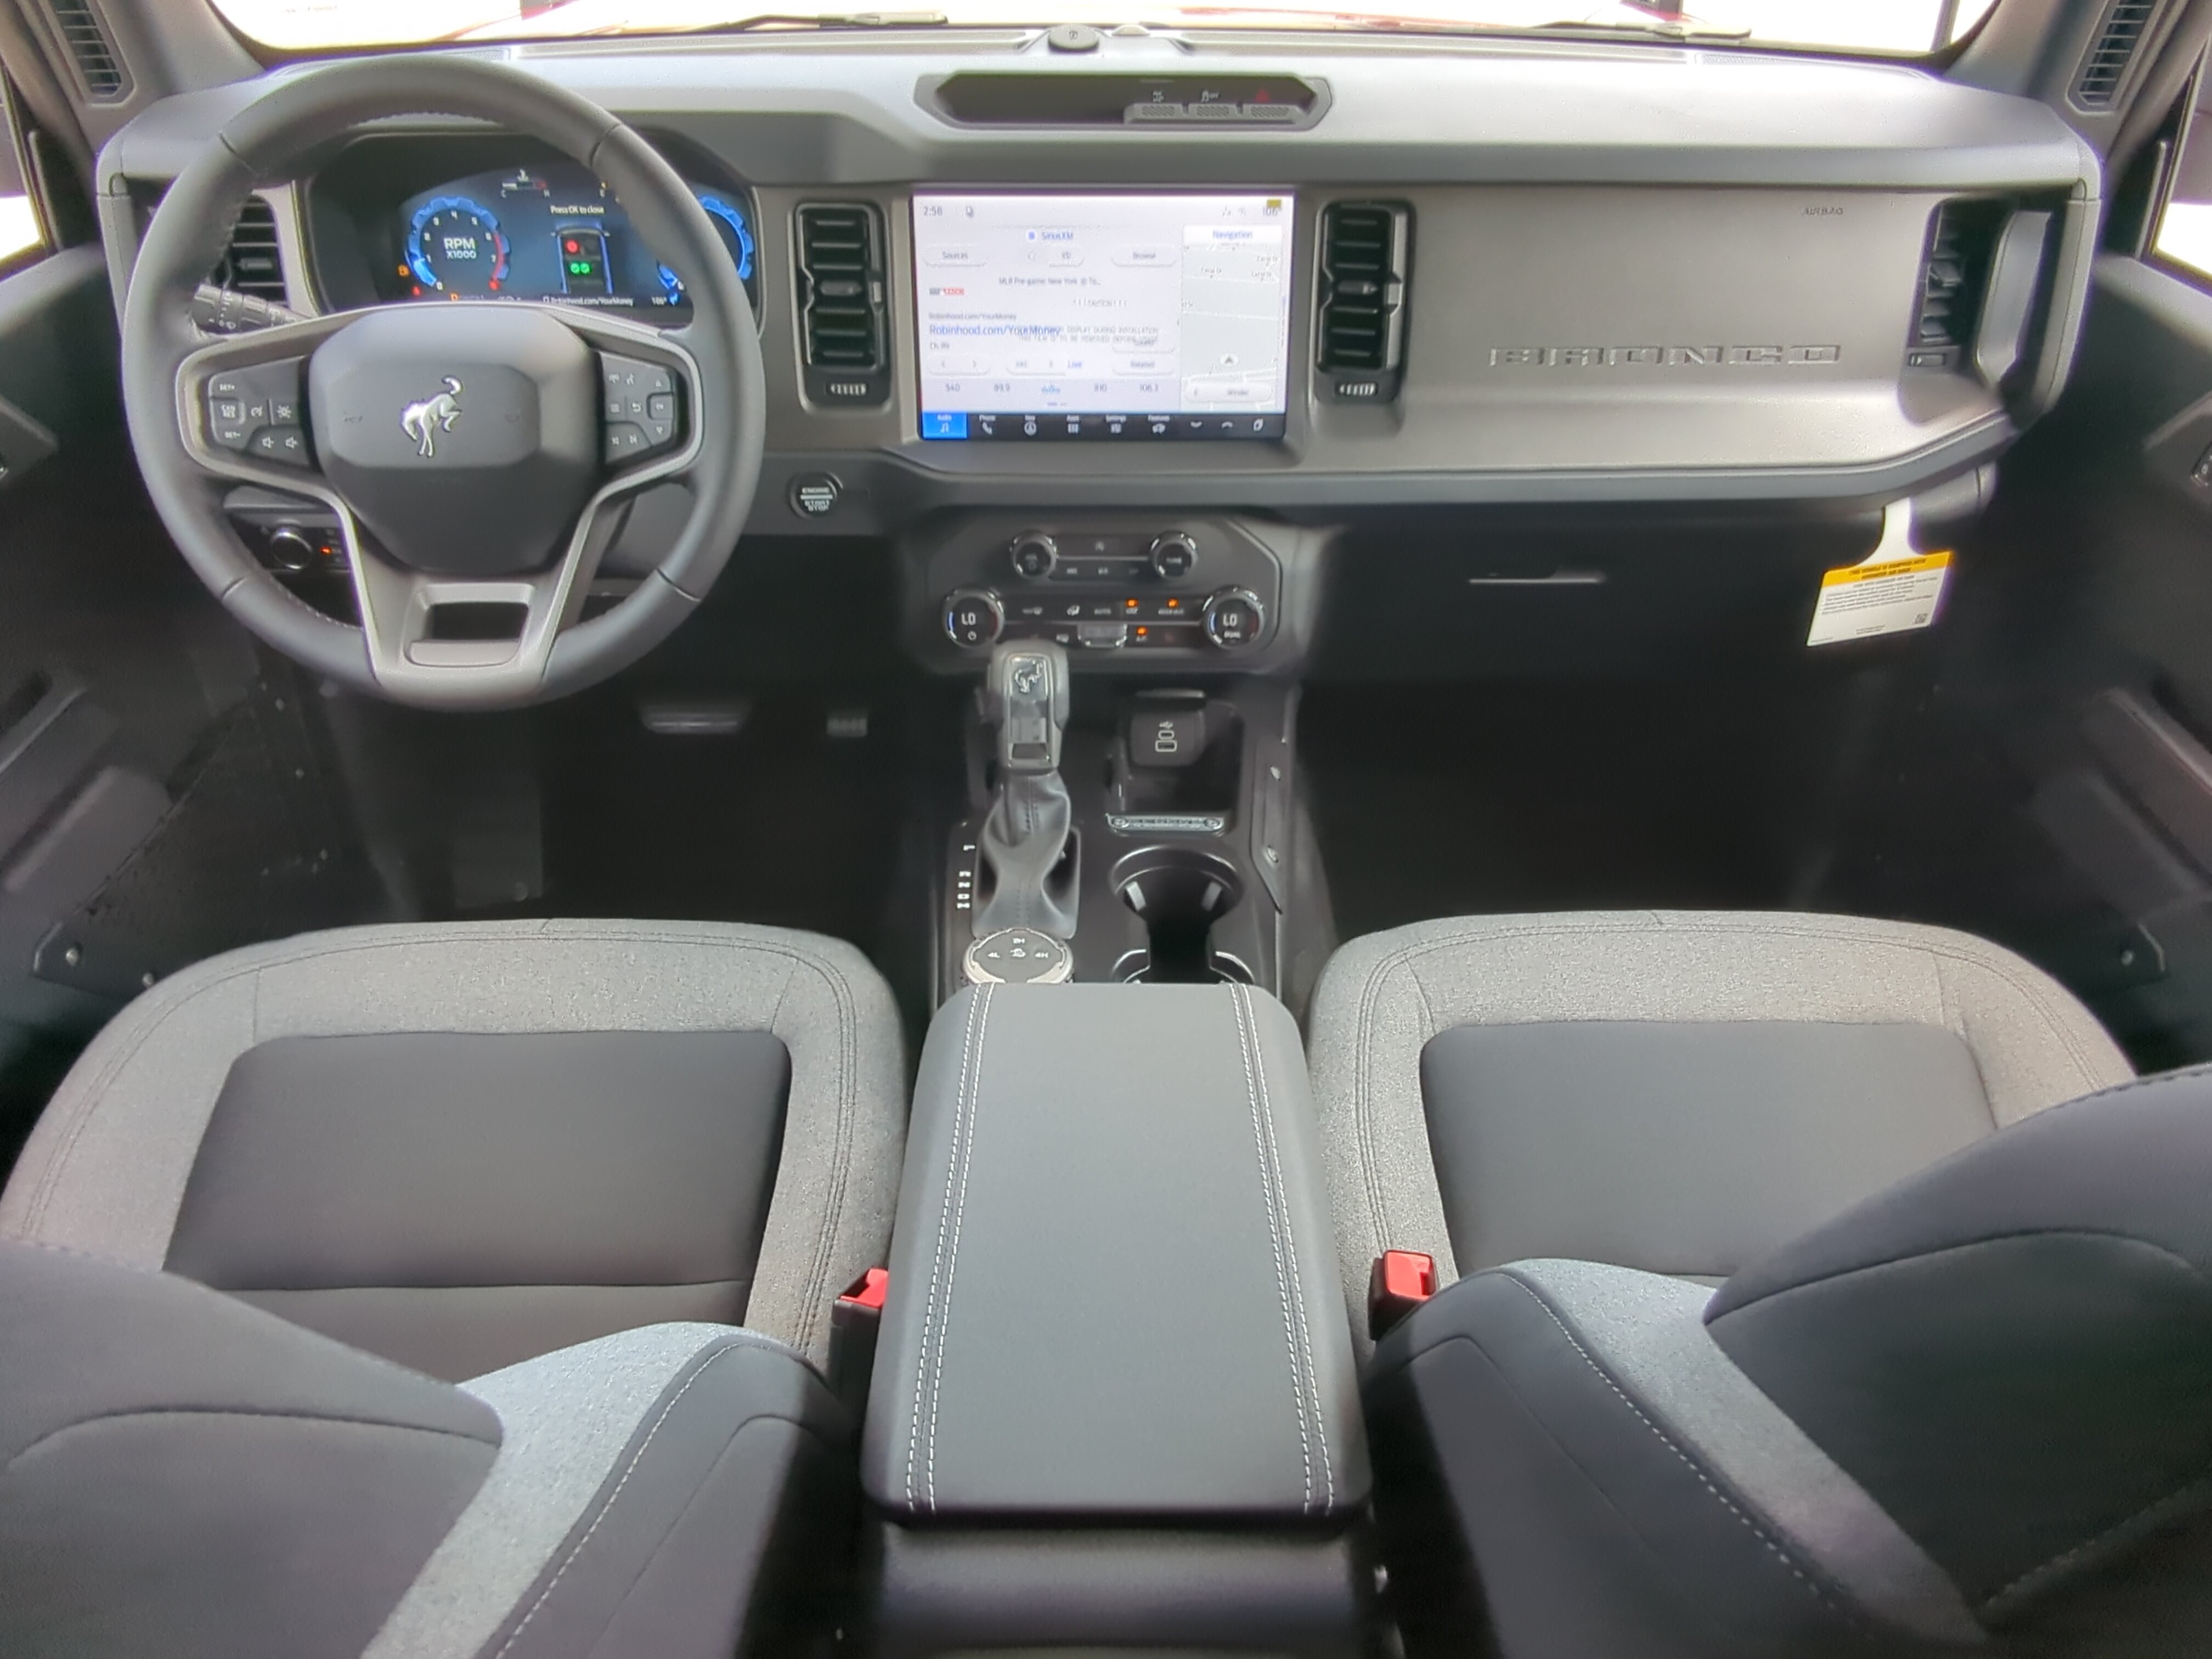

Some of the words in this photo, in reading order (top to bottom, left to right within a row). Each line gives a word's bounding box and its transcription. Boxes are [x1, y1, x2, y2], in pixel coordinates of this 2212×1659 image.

[1212, 229, 1254, 240] Navigation
[443, 238, 476, 250] RPM
[446, 251, 477, 260] X1000
[929, 325, 1061, 336] Robinhood.com/YourMoney
[1489, 346, 1841, 366] BRONCO
[961, 612, 977, 625] LO
[1222, 613, 1238, 627] LO
